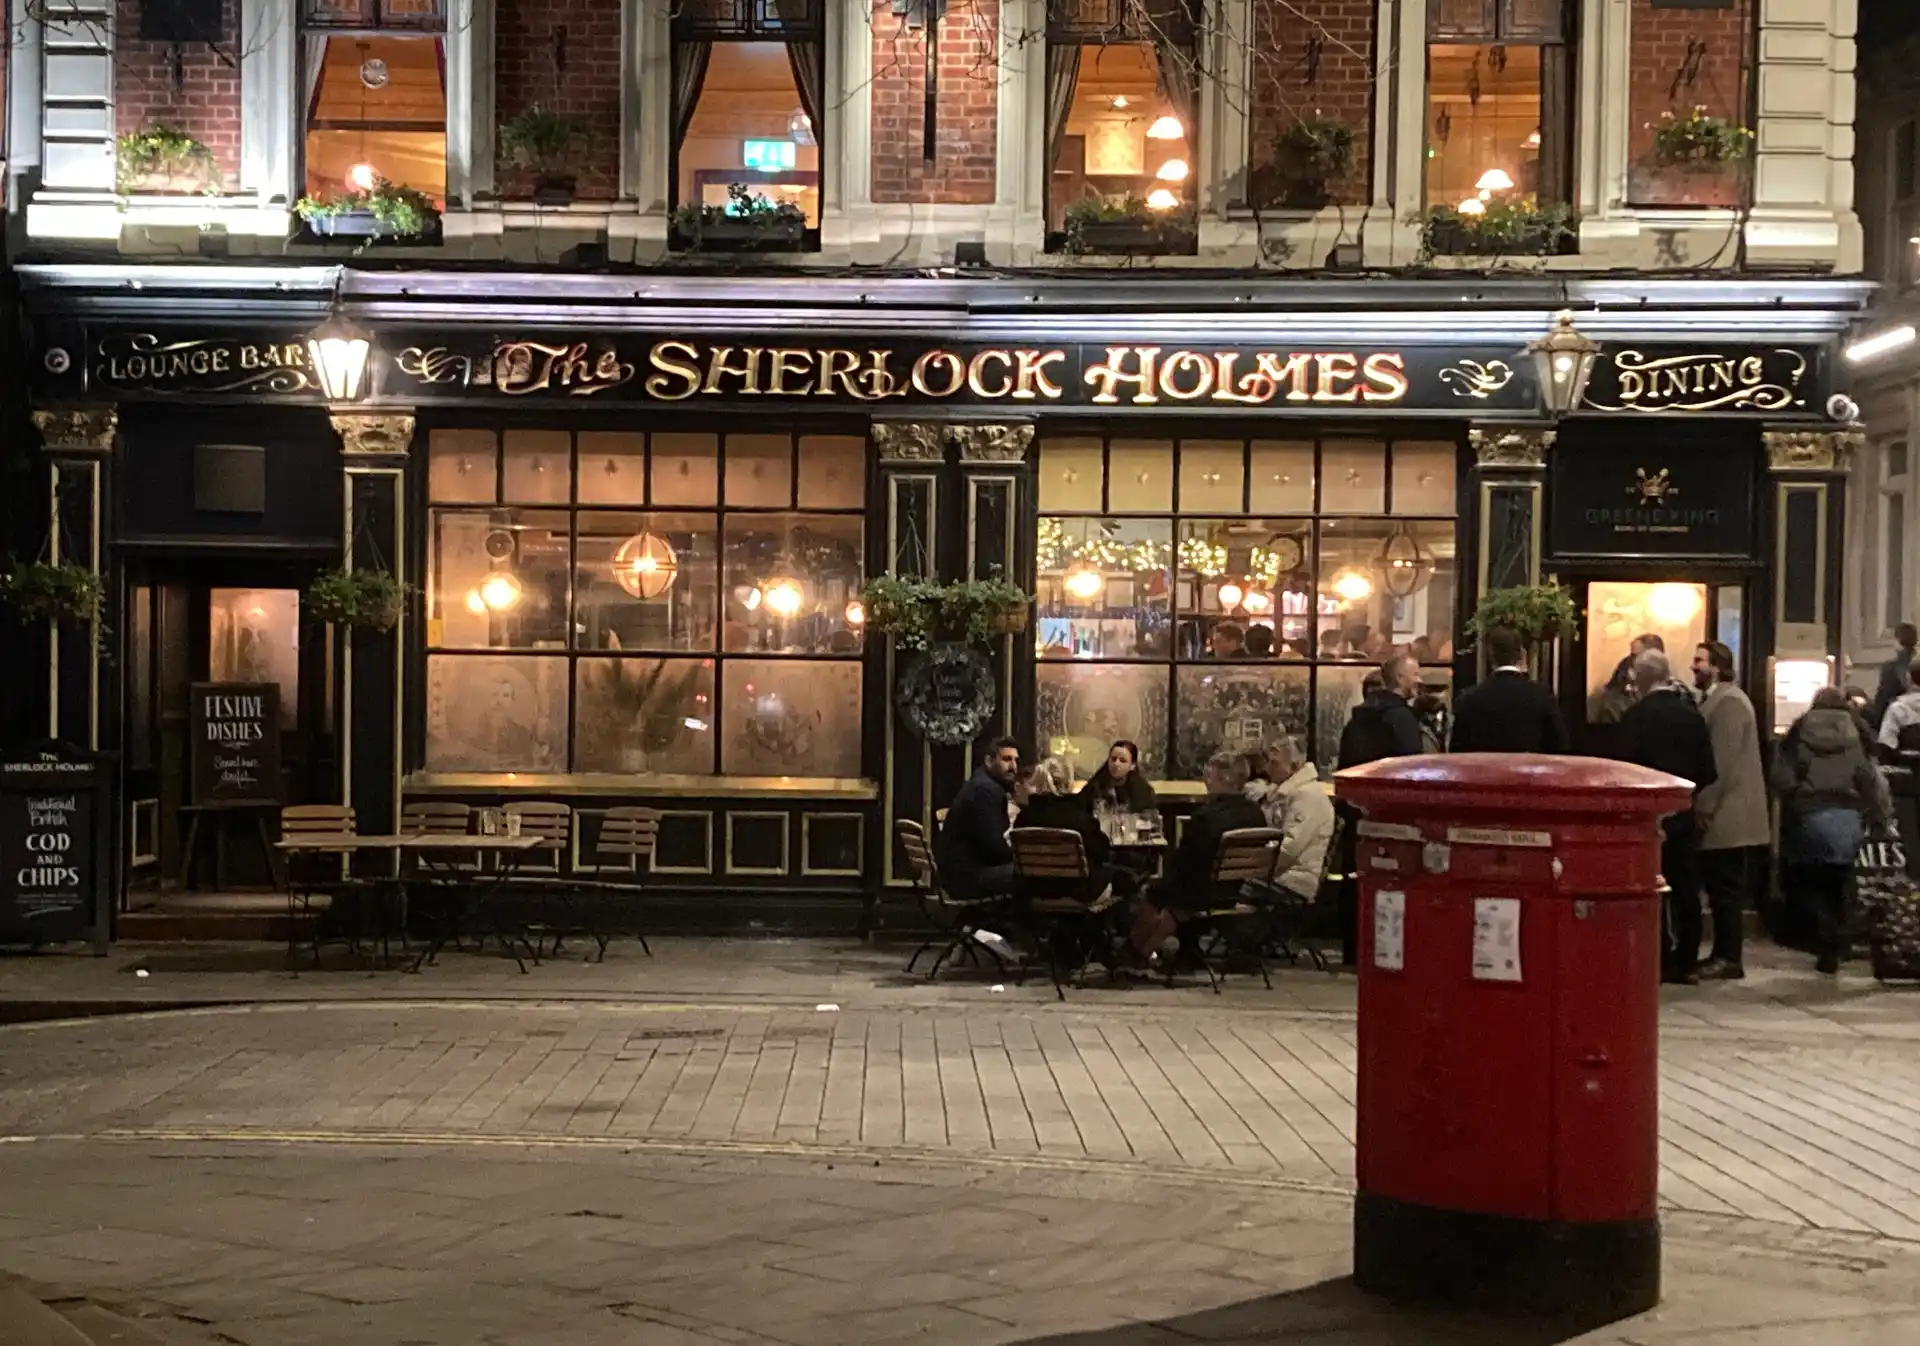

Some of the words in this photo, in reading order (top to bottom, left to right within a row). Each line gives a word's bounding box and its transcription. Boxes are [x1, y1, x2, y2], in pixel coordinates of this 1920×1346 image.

[111, 348, 230, 379] LOUNGE
[240, 343, 305, 369] BAR
[494, 342, 635, 395] The
[644, 341, 1066, 400] SHERLOCK
[1084, 346, 1408, 403] HOLMES
[1617, 355, 1764, 400] DINING
[204, 694, 266, 718] FESTIVE
[207, 721, 264, 740] DISHES
[25, 832, 72, 851] COD
[36, 853, 65, 865] AND
[17, 866, 81, 887] CHIPS
